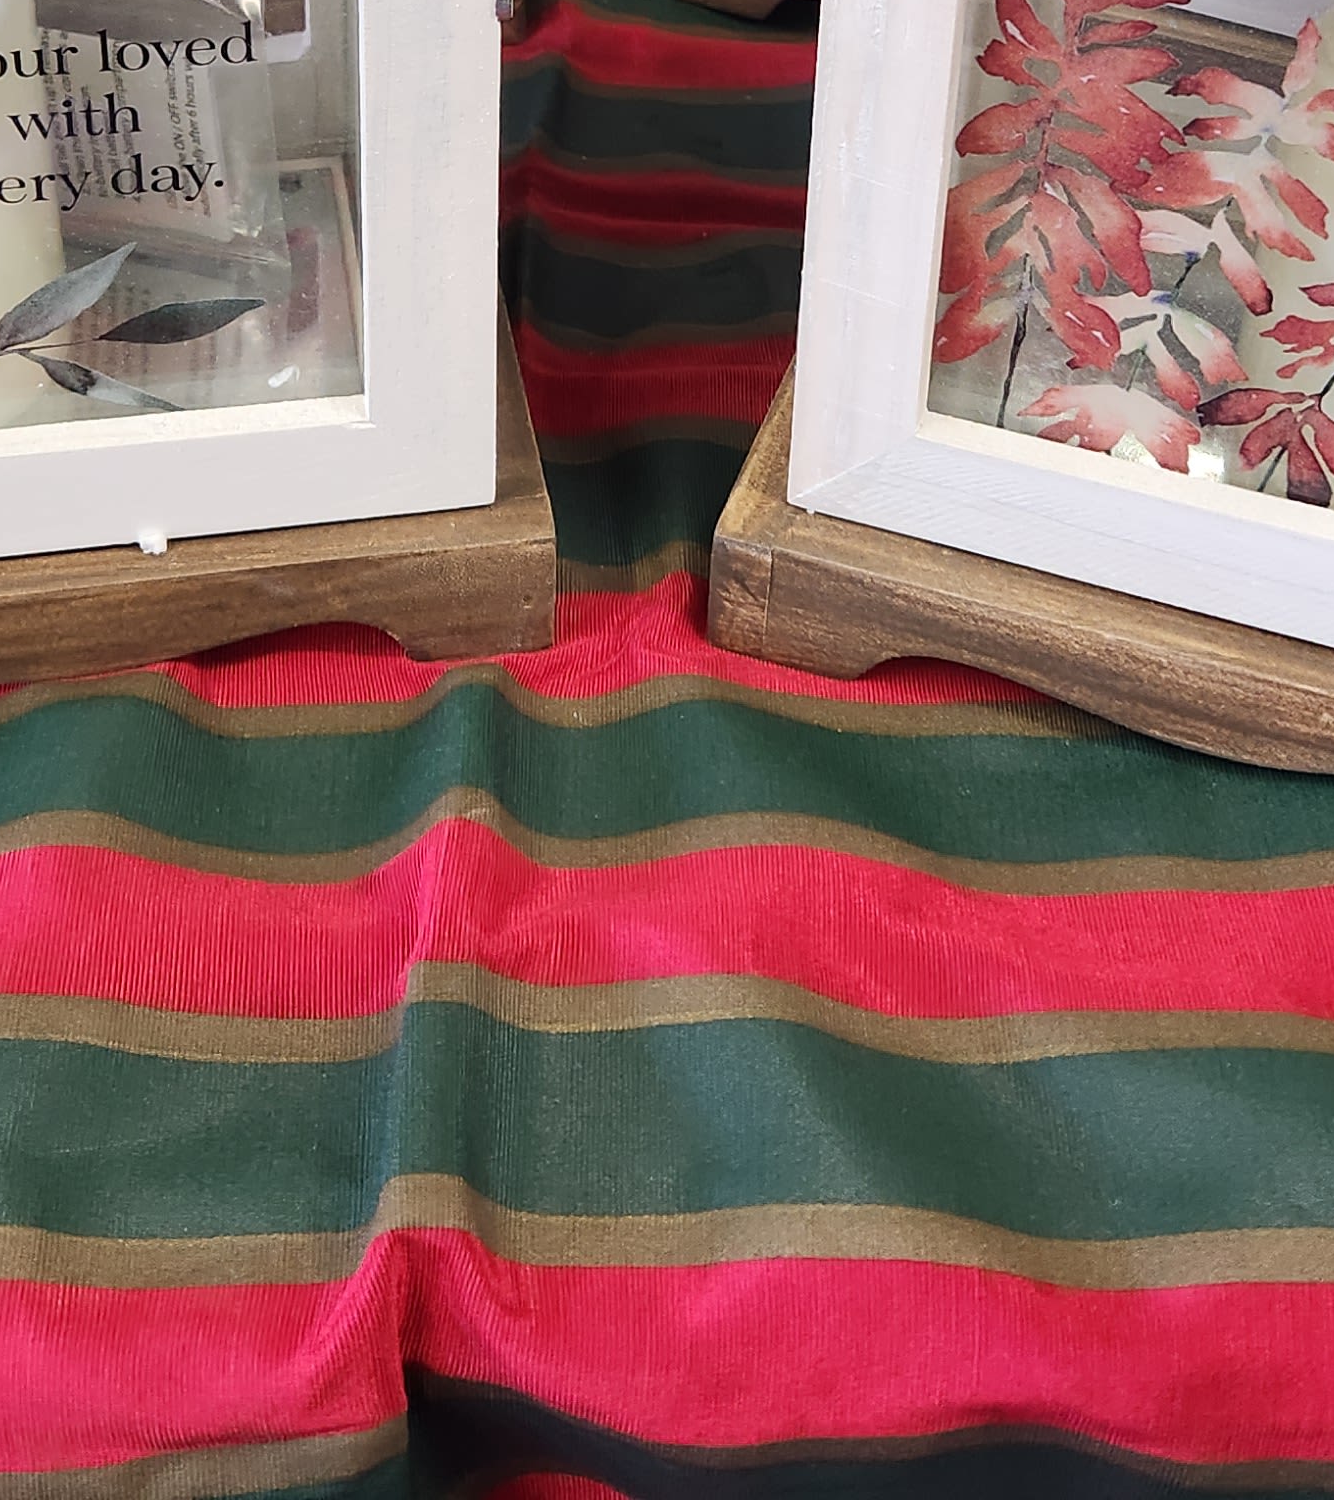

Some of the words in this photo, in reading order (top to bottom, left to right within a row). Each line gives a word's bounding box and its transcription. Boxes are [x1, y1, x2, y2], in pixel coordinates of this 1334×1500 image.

[98, 20, 259, 74] loved
[8, 92, 143, 142] with
[110, 153, 225, 202] day.
